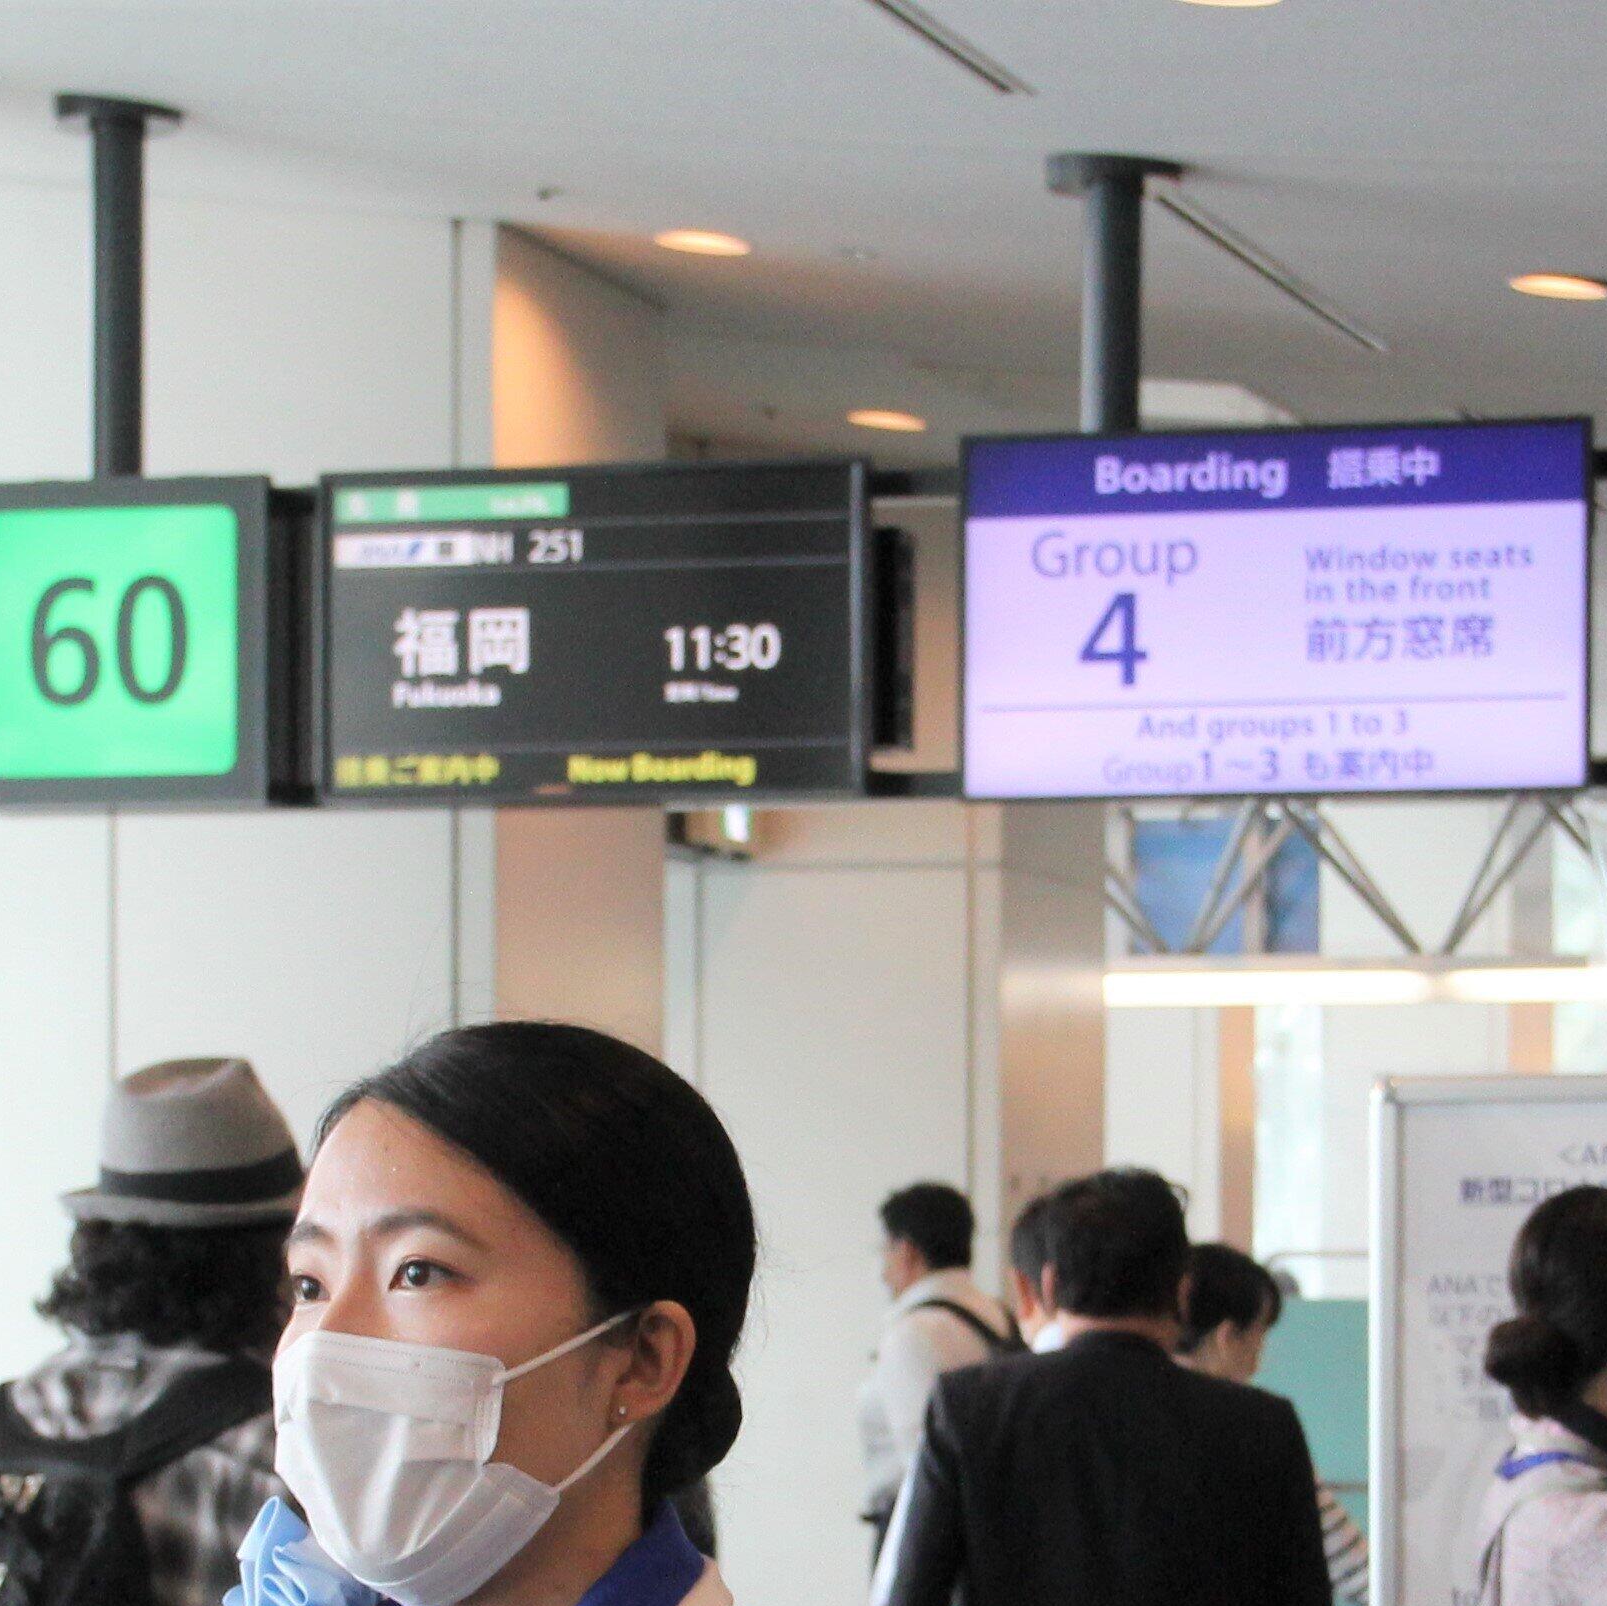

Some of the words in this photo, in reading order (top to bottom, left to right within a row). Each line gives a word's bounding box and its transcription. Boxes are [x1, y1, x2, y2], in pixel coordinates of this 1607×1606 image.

[1095, 453, 1288, 499] Boarding
[527, 528, 585, 563] 251
[1031, 530, 1198, 584] Group
[1305, 544, 1438, 571] Window
[1450, 544, 1534, 569] seats
[1305, 579, 1334, 601] in
[1346, 577, 1400, 601] the
[1410, 575, 1491, 600] front
[28, 575, 190, 707] 60
[394, 606, 531, 677] 福岡
[663, 622, 782, 673] 11:30
[1078, 591, 1149, 686] 4
[1306, 614, 1494, 662] 前方窓席
[1137, 715, 1195, 739] And
[1207, 712, 1315, 743] groups
[1328, 711, 1339, 734] 1
[1352, 712, 1382, 734] to
[1395, 710, 1409, 735] 3
[567, 753, 630, 784] Now
[630, 749, 757, 787] Boarding
